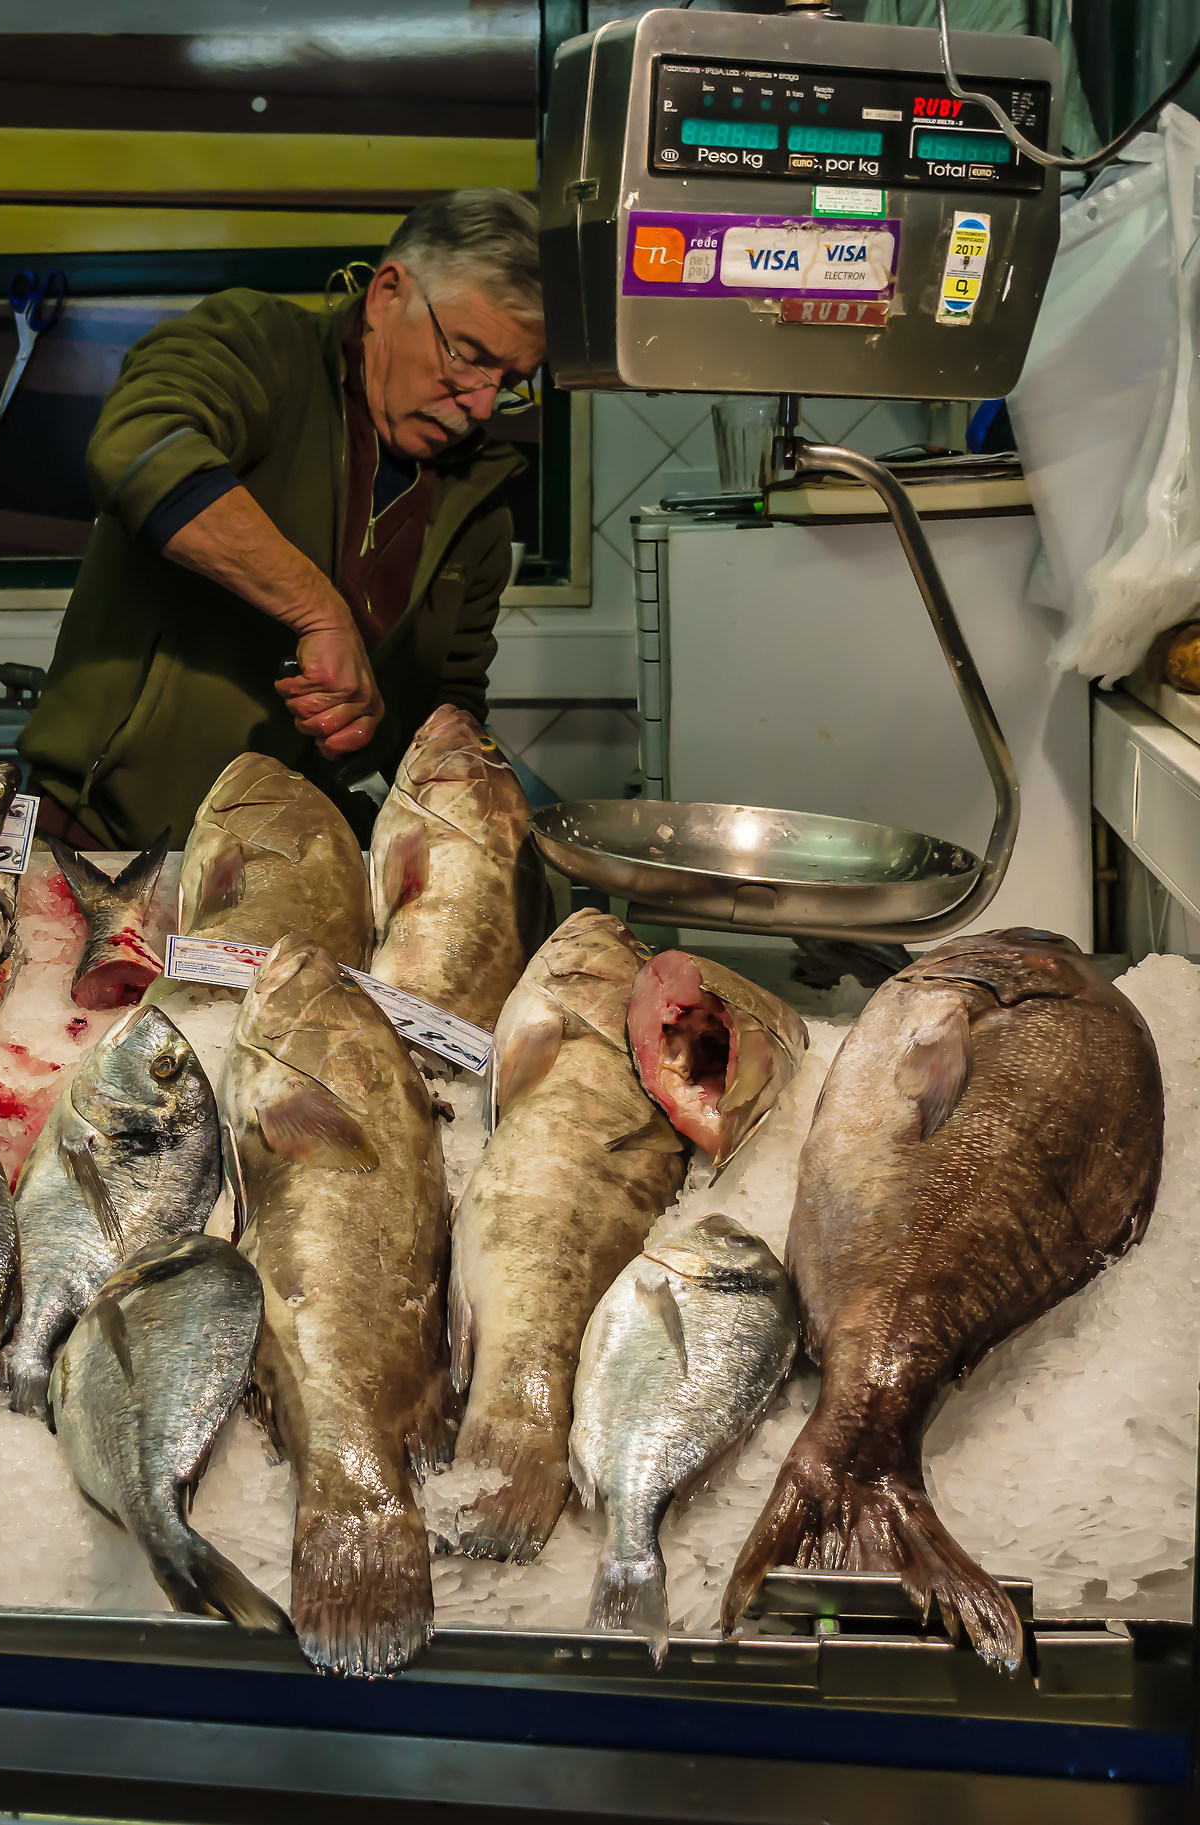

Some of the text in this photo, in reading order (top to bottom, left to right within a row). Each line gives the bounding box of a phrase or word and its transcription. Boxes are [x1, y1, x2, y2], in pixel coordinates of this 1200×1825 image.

[913, 97, 964, 118] RUBY
[698, 148, 763, 168] Peso kg
[825, 158, 856, 172] por
[859, 158, 879, 176] kg
[927, 162, 965, 178] Total
[690, 236, 718, 248] rede
[955, 244, 981, 256] 2017
[689, 255, 711, 266] net
[745, 249, 800, 271] VISA
[824, 244, 867, 262] VISA
[688, 267, 710, 280] pay
[824, 271, 866, 281] ELECTRON
[801, 302, 868, 322] RUBY
